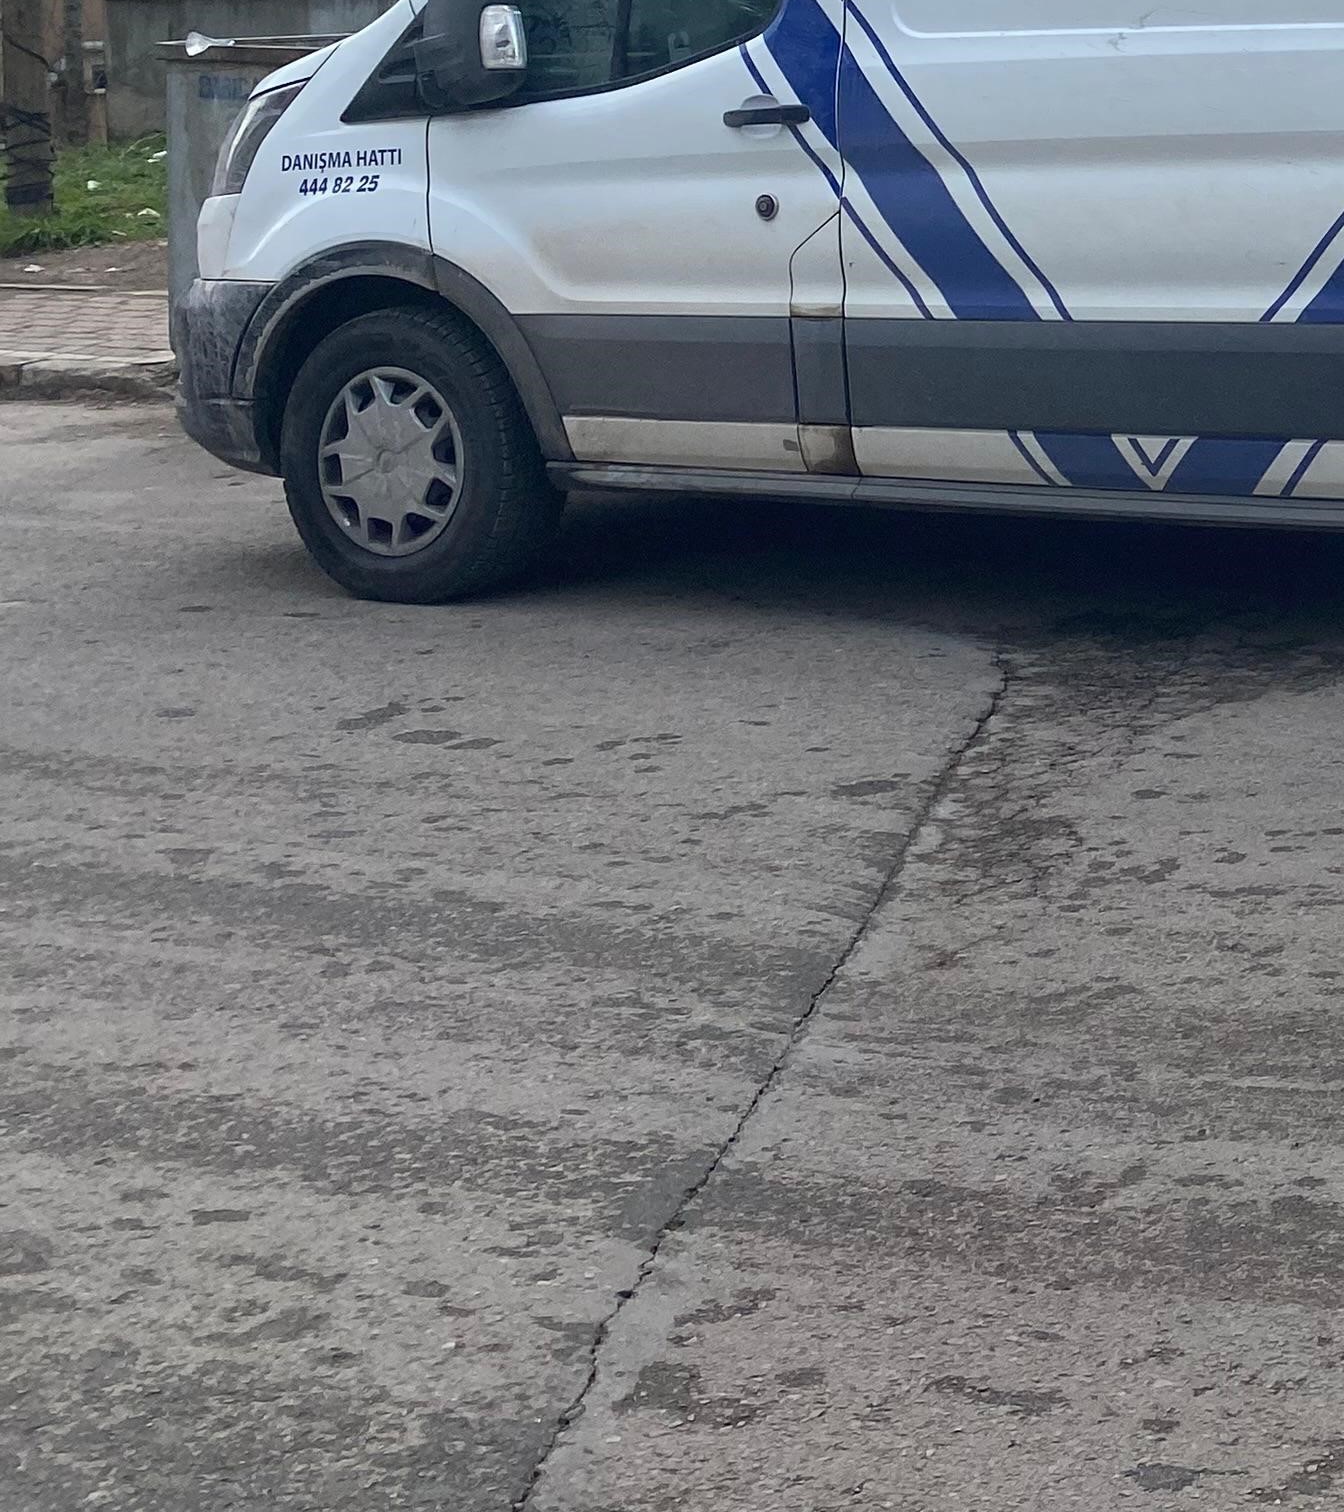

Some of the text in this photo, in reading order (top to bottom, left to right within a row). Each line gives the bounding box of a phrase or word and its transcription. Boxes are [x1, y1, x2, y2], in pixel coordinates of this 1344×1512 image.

[281, 148, 402, 173] DANIŞMA HATTI
[299, 175, 380, 196] 444 82 25
